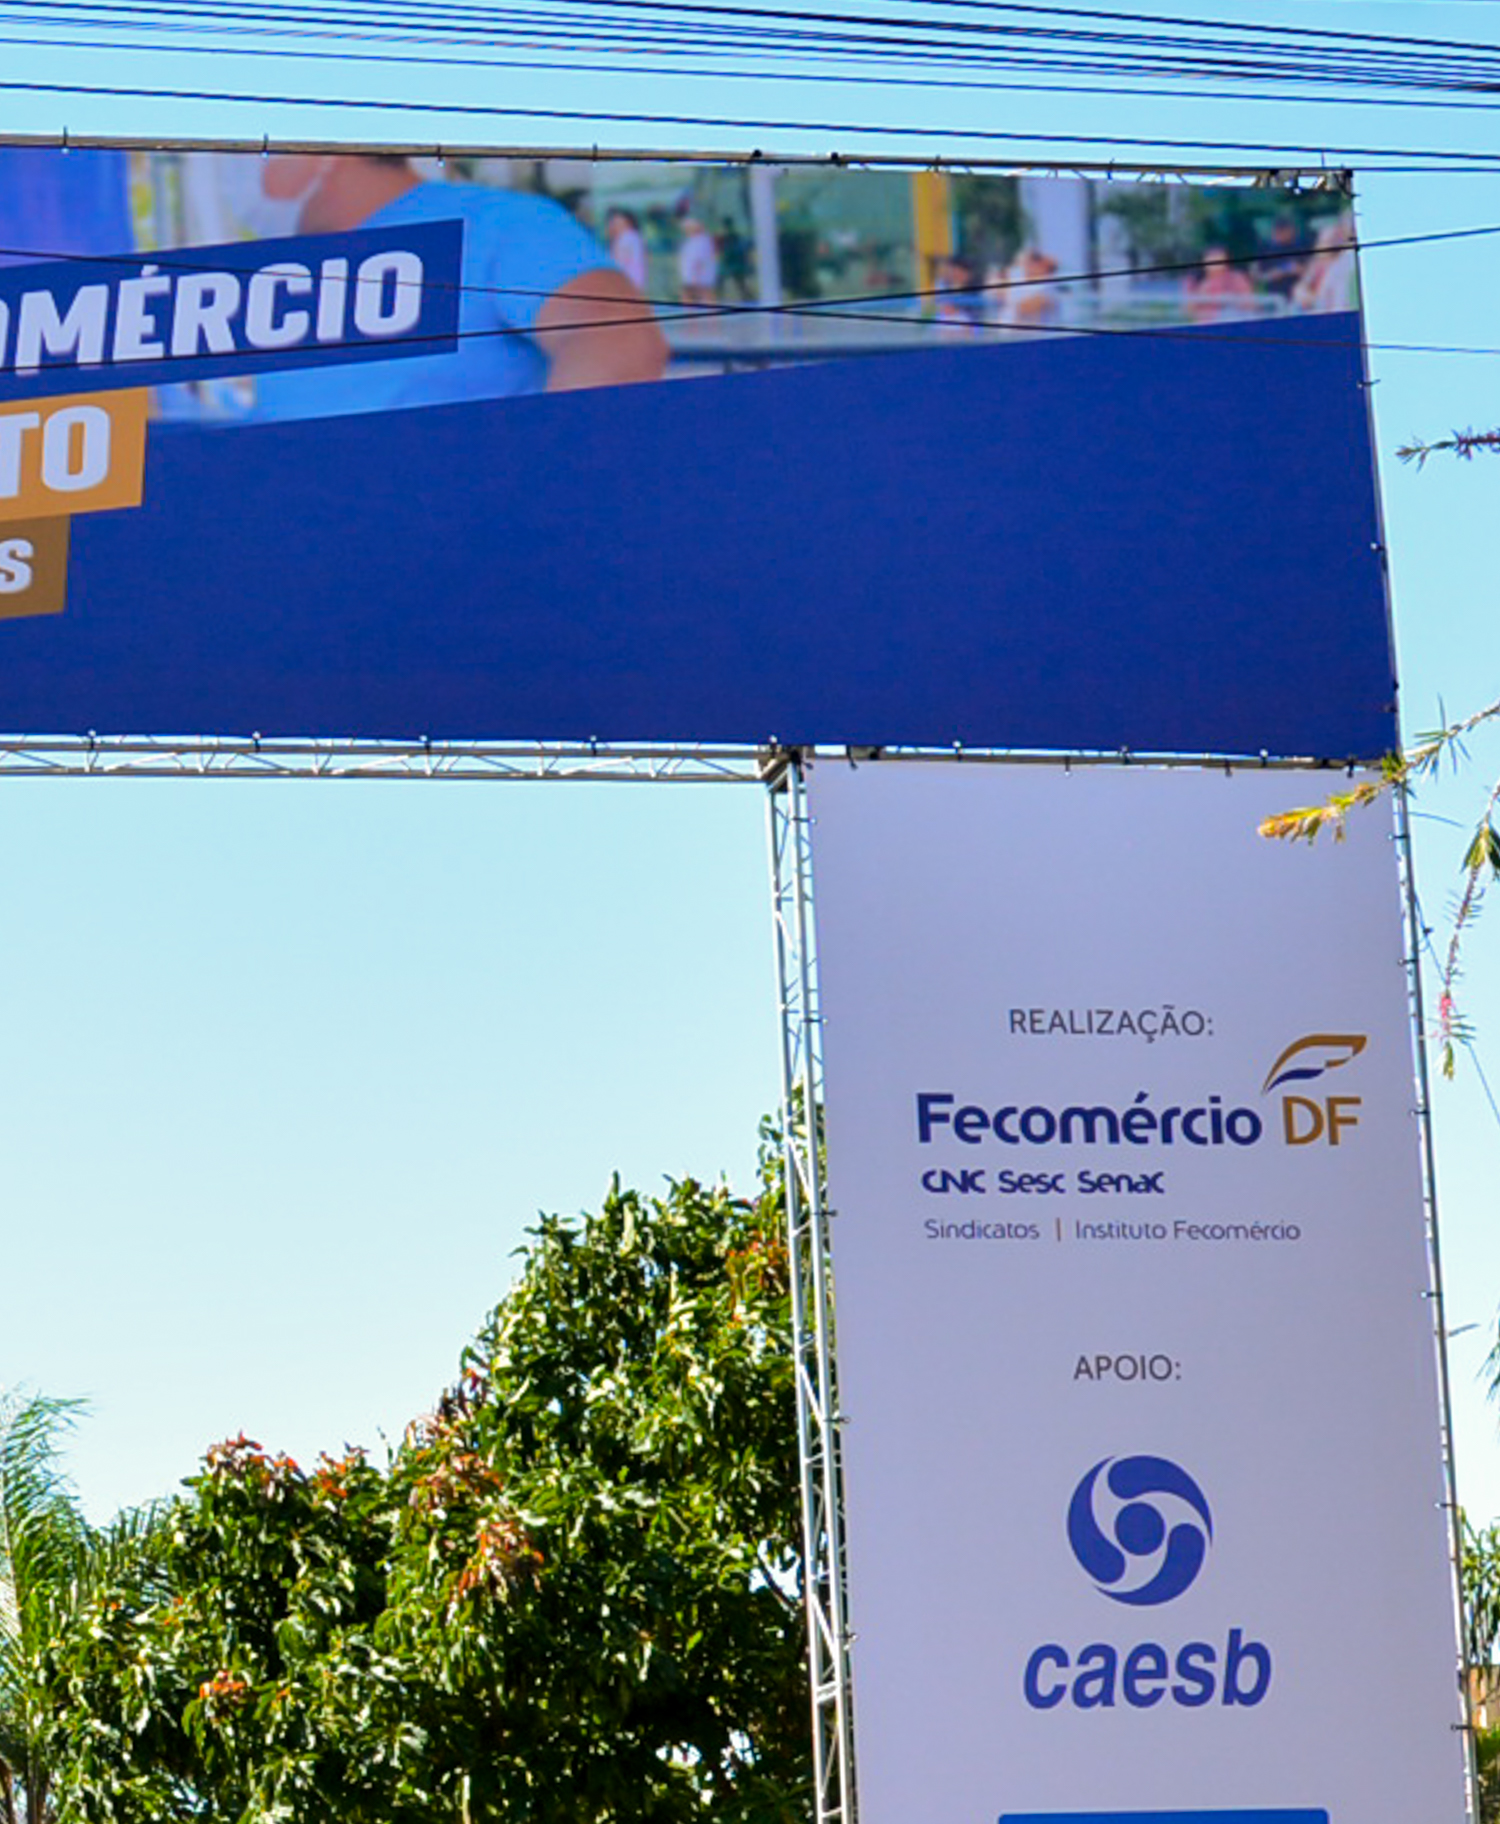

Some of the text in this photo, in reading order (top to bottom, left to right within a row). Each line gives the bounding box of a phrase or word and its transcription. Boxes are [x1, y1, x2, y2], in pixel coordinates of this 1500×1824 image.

[1008, 1004, 1215, 1044] REALIZAÇÃO:
[916, 1091, 1364, 1146] Fecomércio DF
[920, 1169, 987, 1194] CNC
[998, 1169, 1067, 1195] Sesc
[924, 1218, 1302, 1242] Sindicatos Instituto Fecomércio
[1073, 1354, 1182, 1382] APOIO:
[1023, 1628, 1272, 1710] caesb
